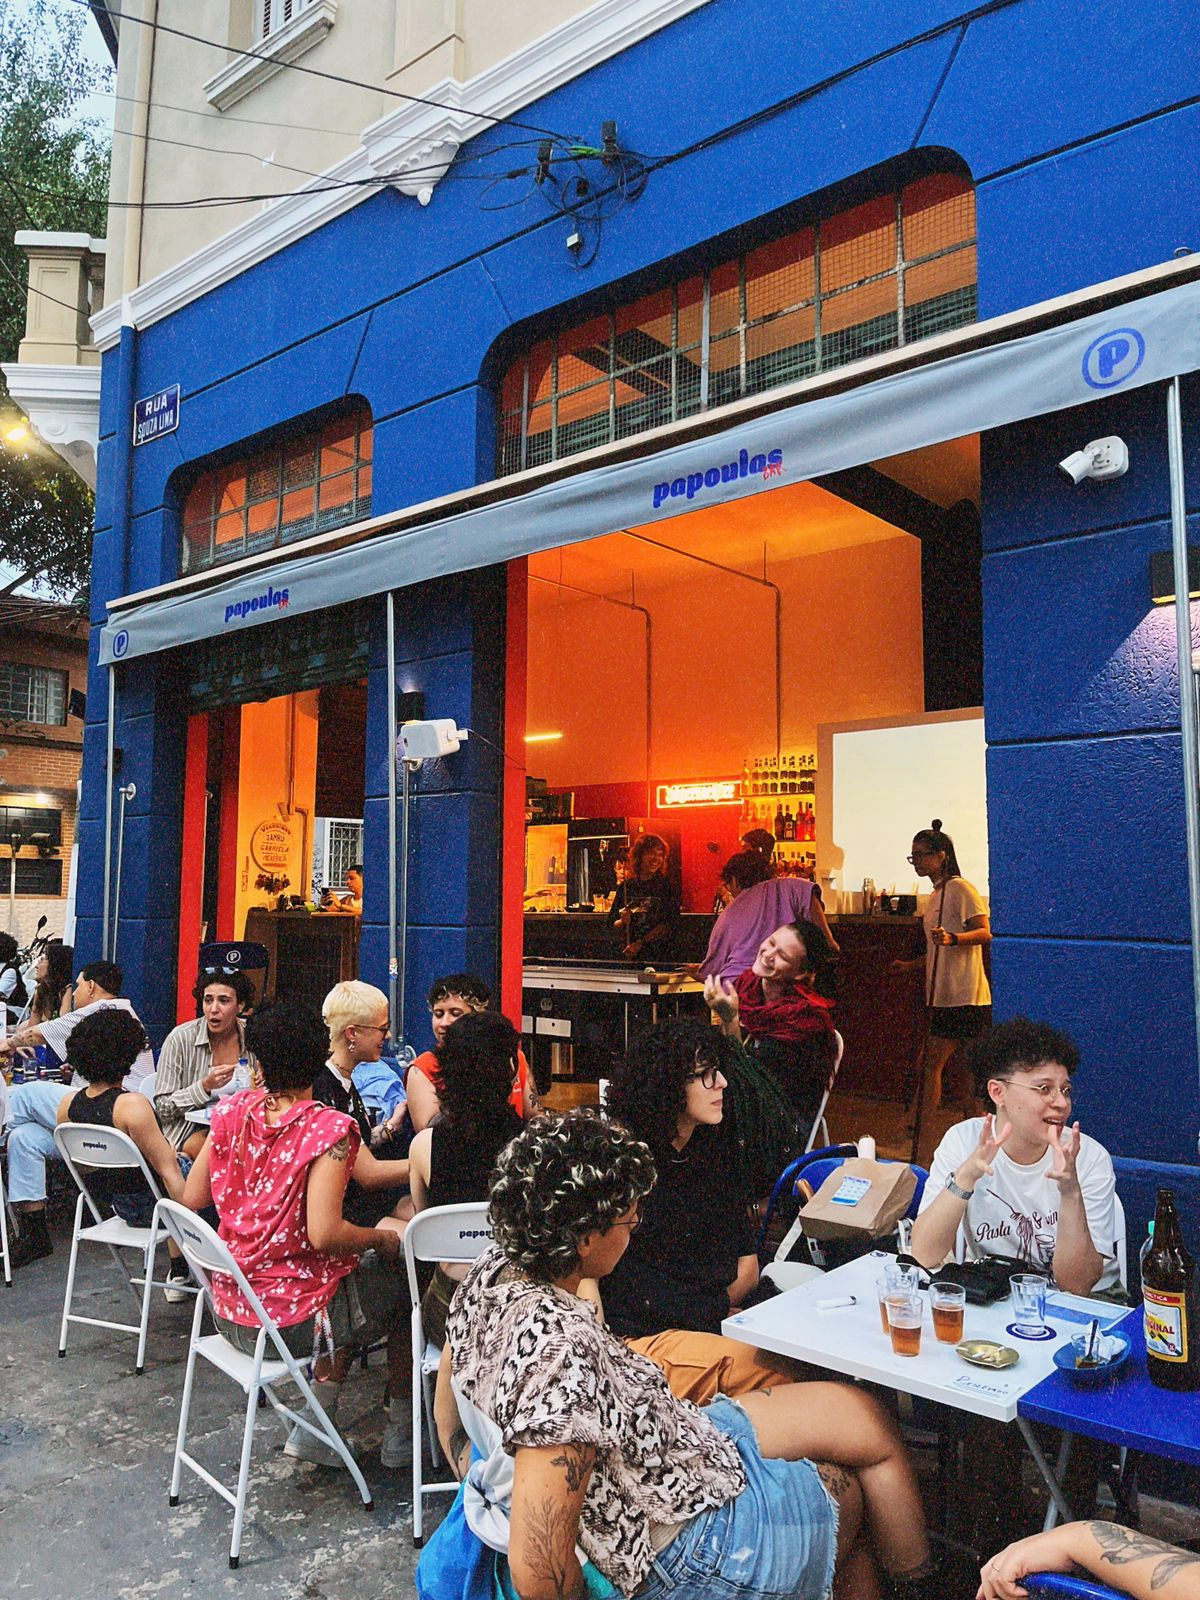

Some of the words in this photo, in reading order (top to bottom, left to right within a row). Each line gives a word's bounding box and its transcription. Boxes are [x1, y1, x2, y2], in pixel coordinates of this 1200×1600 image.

[145, 393, 168, 416] RUA
[138, 416, 158, 440] SOUZA
[159, 409, 174, 431] LIMA
[652, 448, 783, 509] papoulas
[224, 586, 289, 624] papoulas
[975, 1220, 1011, 1243] Pasta
[1045, 1209, 1058, 1226] vin
